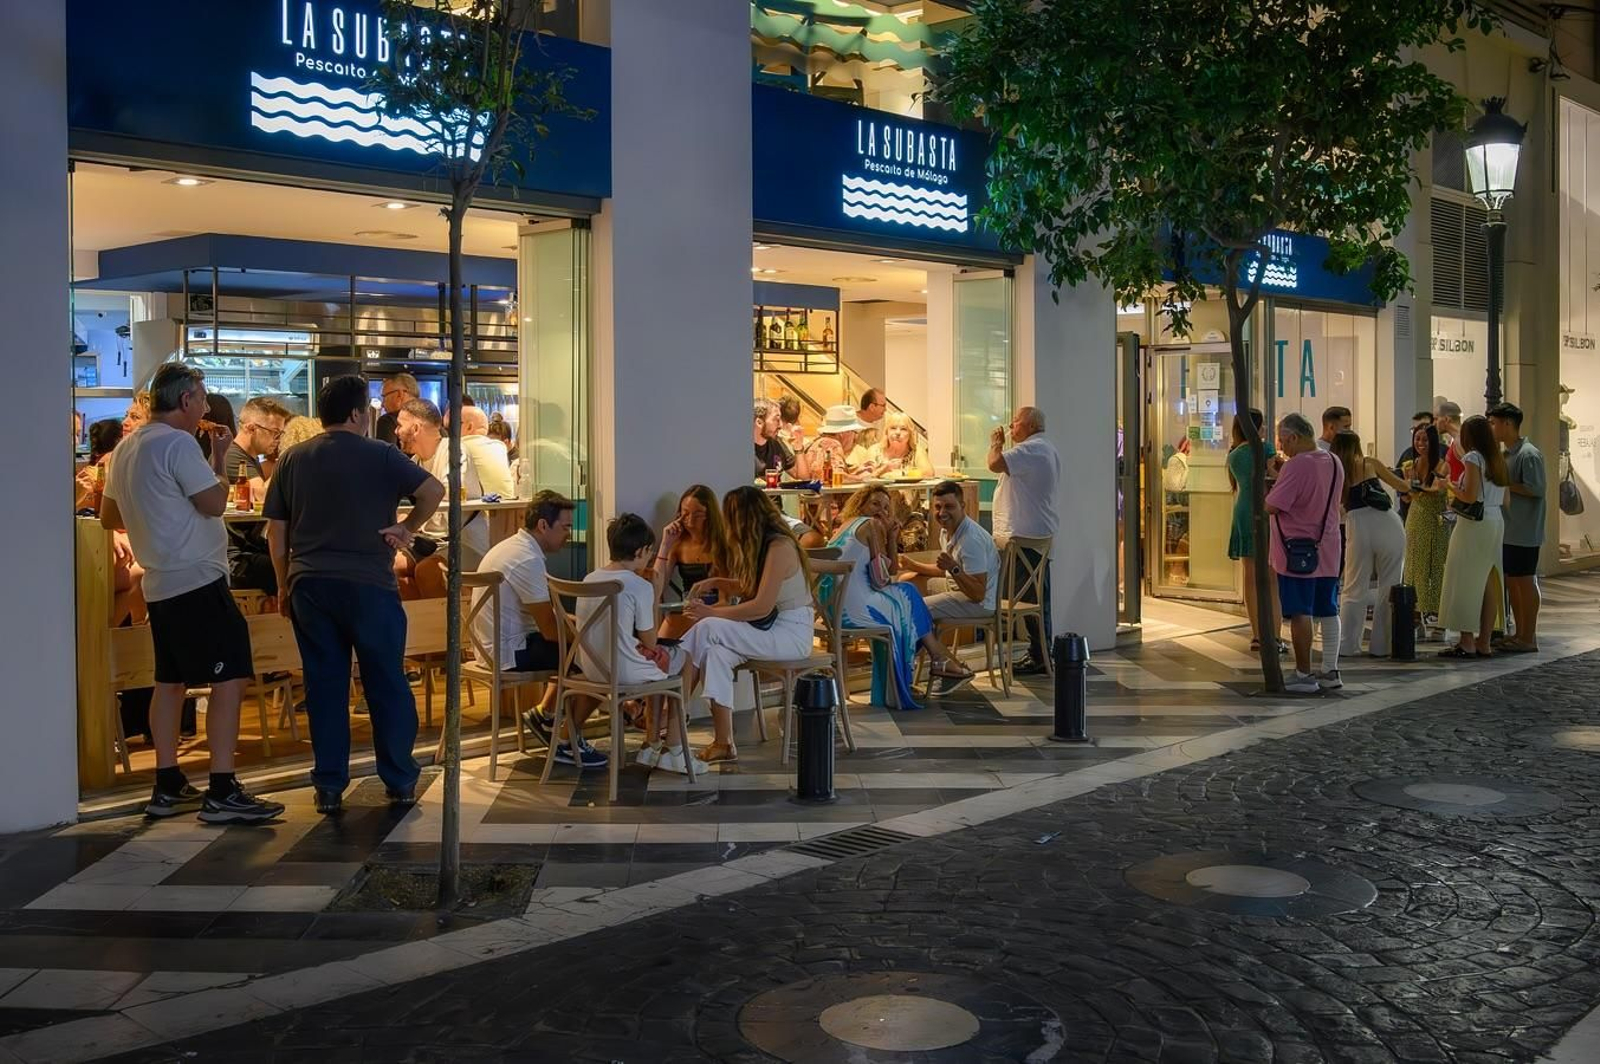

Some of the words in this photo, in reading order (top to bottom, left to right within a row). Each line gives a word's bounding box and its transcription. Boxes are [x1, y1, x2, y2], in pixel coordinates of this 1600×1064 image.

[282, 0, 316, 49] LA
[858, 119, 876, 157] LA
[883, 125, 956, 171] SUBASTA
[904, 166, 915, 178] de
[1439, 338, 1474, 353] SILBON
